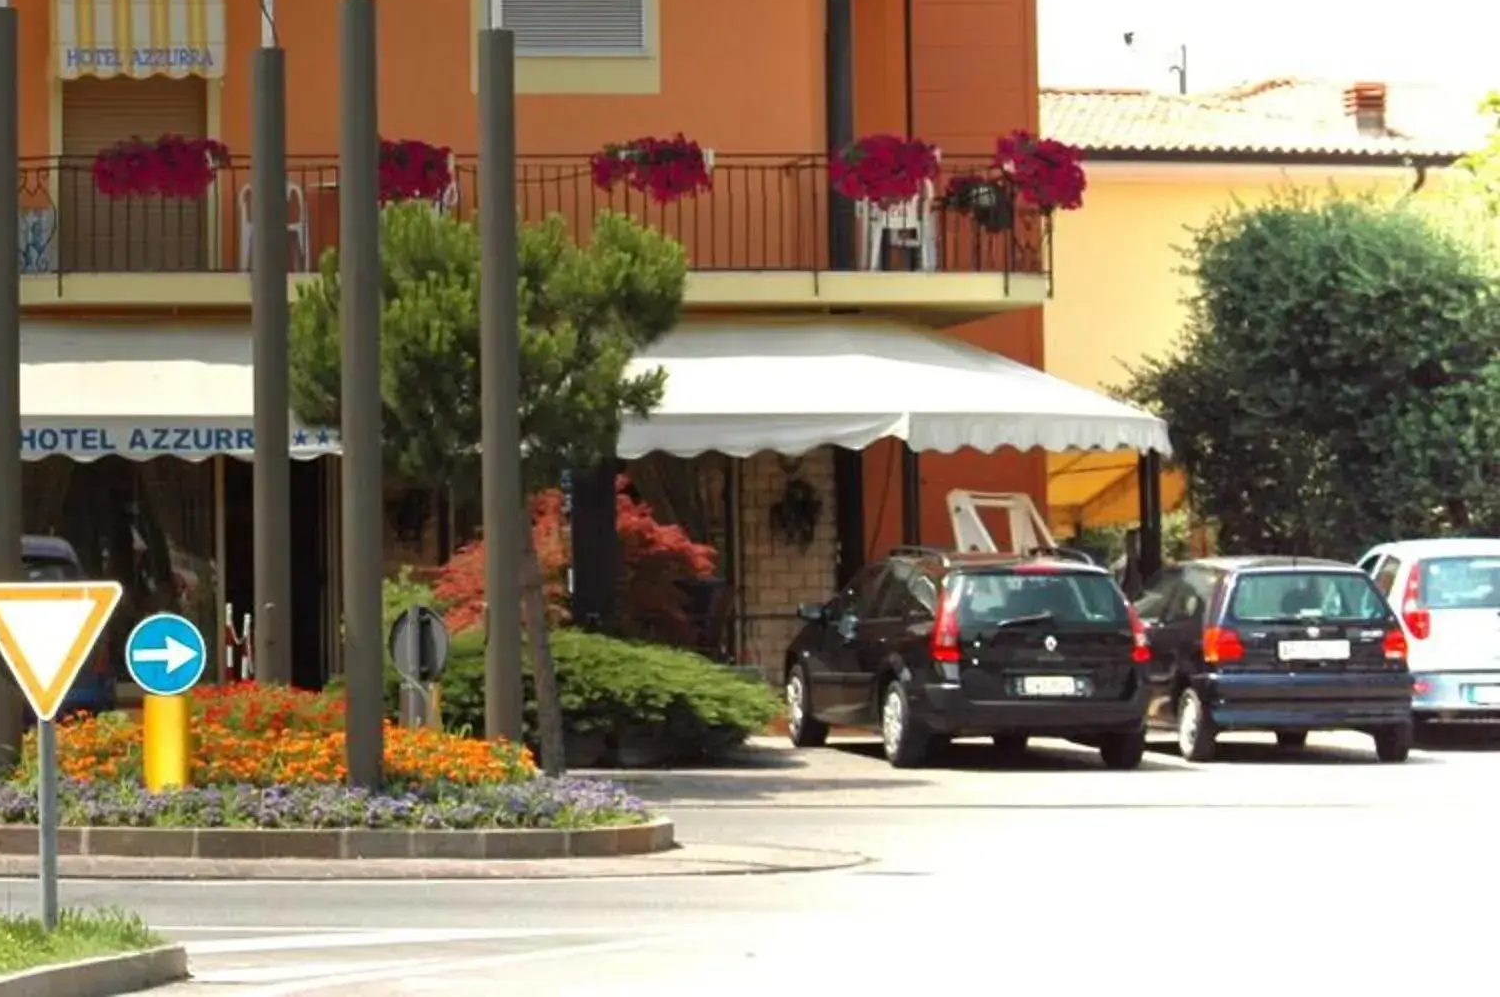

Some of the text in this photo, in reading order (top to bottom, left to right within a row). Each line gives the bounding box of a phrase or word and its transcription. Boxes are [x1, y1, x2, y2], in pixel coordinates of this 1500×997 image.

[66, 47, 215, 66] HOTEL AZZURRA
[18, 427, 255, 451] HOTEL AZZURR
